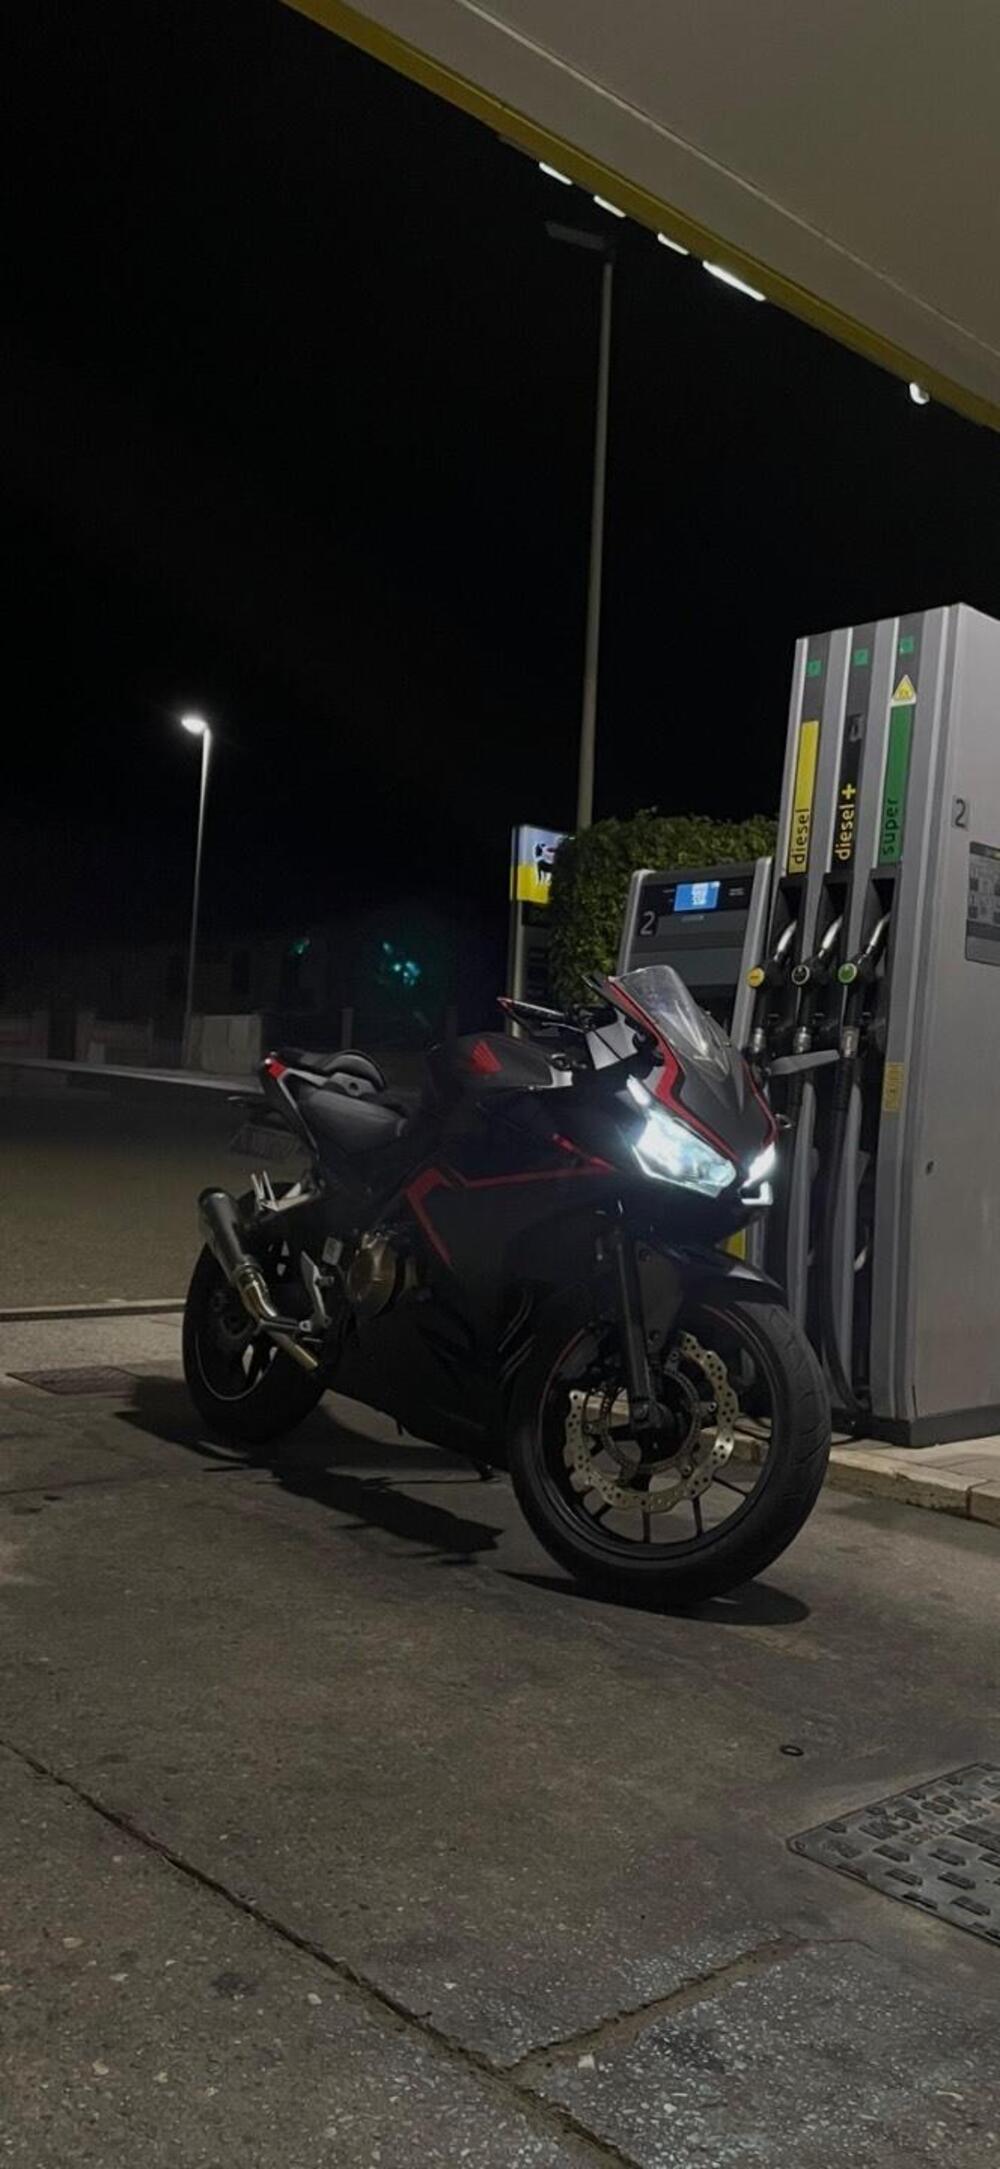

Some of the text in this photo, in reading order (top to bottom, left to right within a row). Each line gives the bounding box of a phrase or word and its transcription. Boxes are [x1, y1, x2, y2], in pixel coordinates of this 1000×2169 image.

[883, 798, 899, 855] super
[954, 799, 967, 829] 2
[791, 808, 809, 864] diesel
[639, 910, 657, 935] 2
